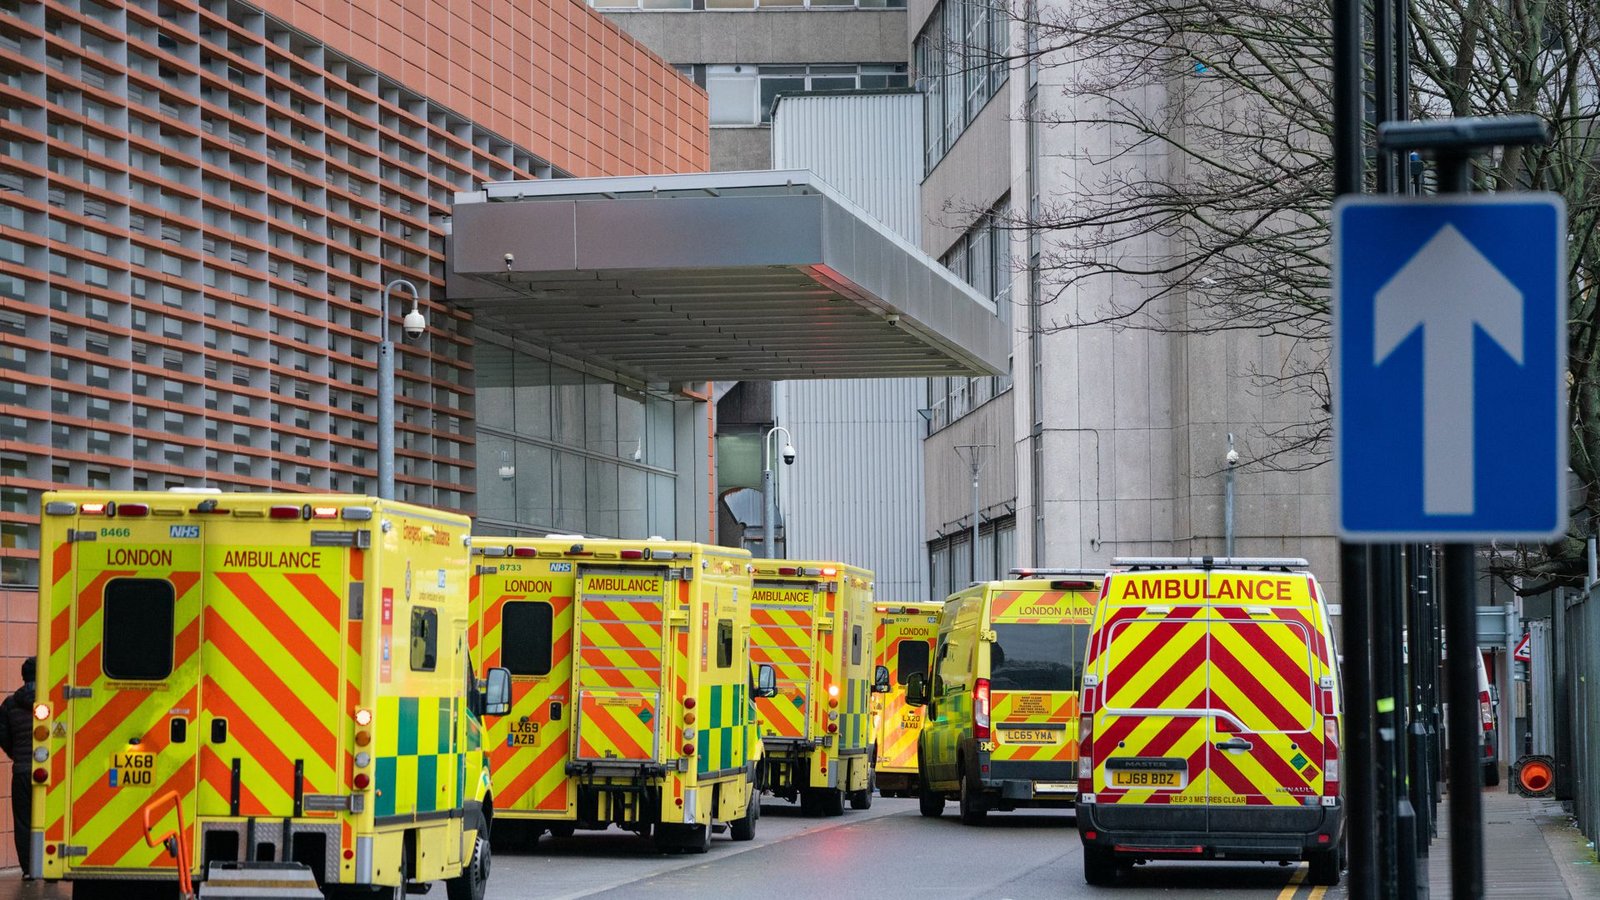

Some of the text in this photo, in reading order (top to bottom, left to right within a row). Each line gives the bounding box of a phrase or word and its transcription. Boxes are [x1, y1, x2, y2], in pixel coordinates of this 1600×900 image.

[101, 528, 130, 537] 8466
[170, 526, 199, 538] NHS
[107, 549, 321, 568] LONDON AMBULANCE
[550, 563, 571, 572] NHS
[505, 578, 659, 592] LONDON AMBULANCE
[1122, 579, 1292, 600] AMBULANCE
[751, 590, 809, 602] AMBULANCE
[1020, 606, 1062, 615] LONDON
[900, 627, 929, 636] LONDON
[510, 722, 539, 733] LX69
[514, 734, 535, 745] AZB
[1007, 731, 1053, 740] LC65 YMA
[114, 754, 153, 768] LX68
[1117, 773, 1174, 784] LJ68 BDZ
[1223, 796, 1246, 804] CLEAR
